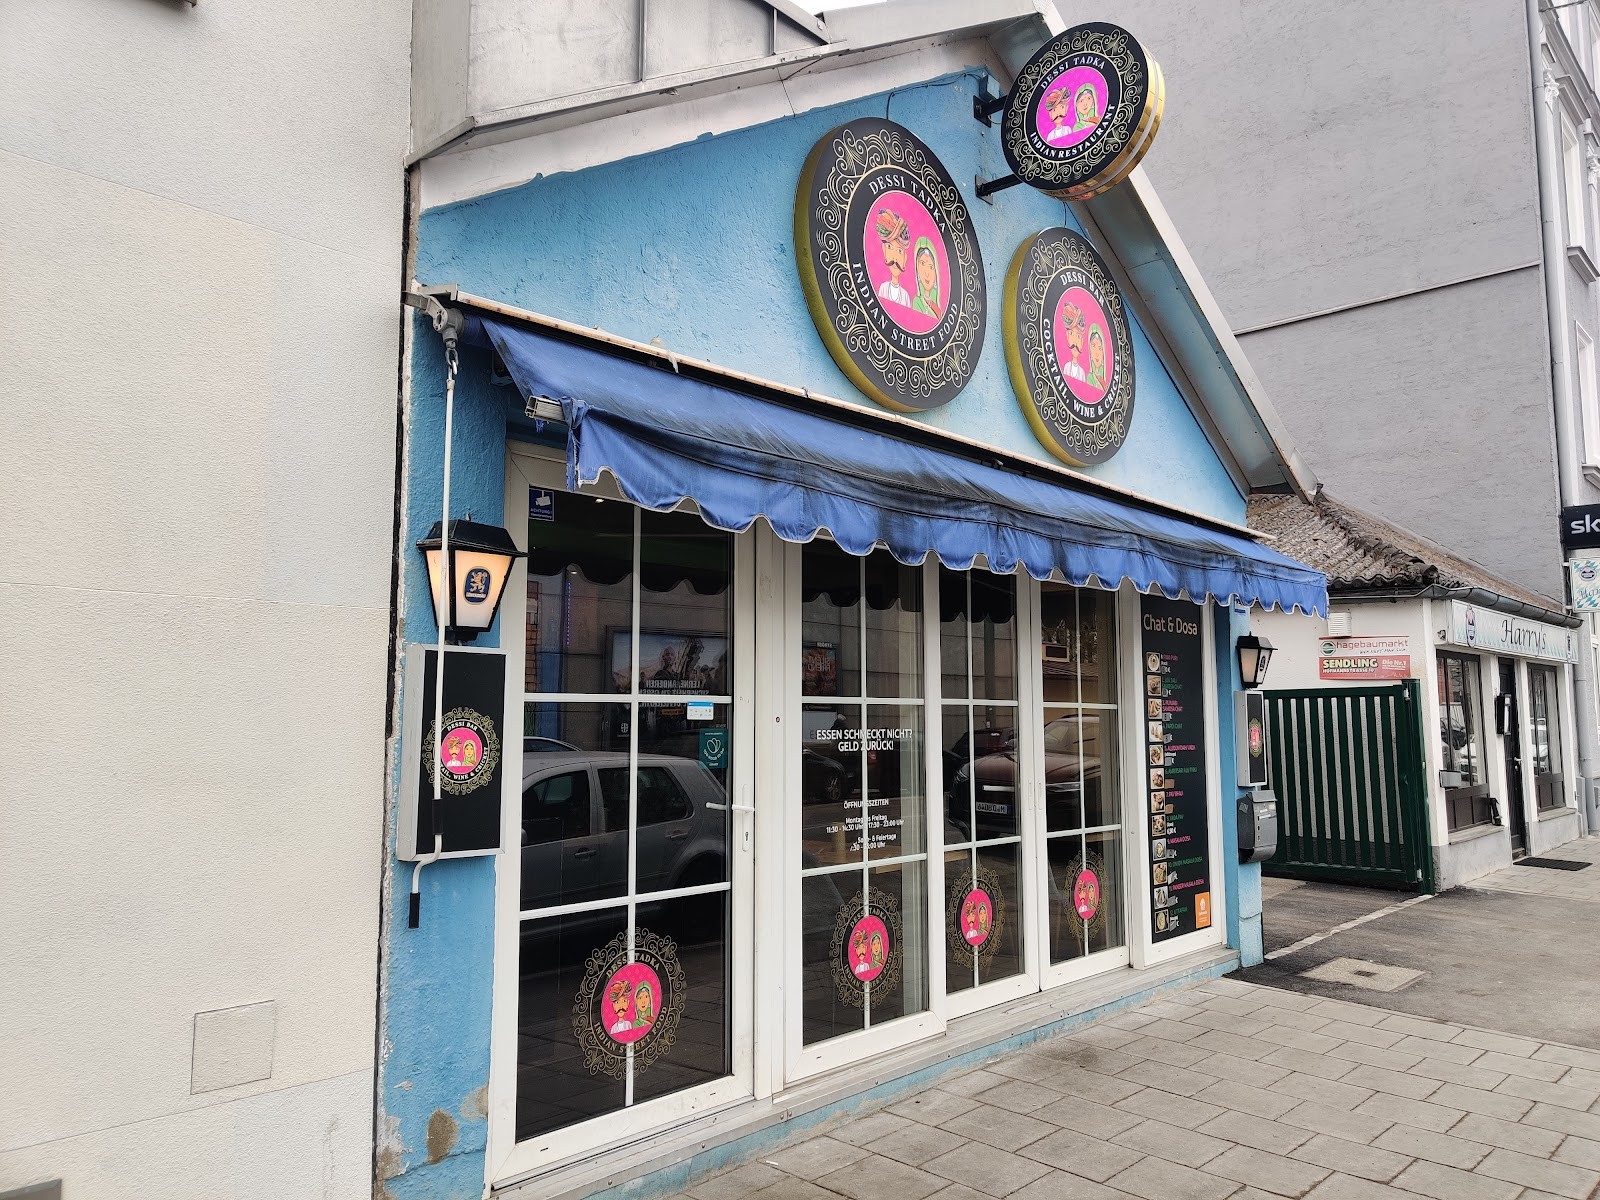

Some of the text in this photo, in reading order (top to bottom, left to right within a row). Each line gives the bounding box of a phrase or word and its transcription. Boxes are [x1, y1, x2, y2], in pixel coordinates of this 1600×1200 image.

[1040, 55, 1106, 90] DESSI TADKA
[1030, 103, 1116, 159] INDIAN RESTAURANT
[869, 174, 948, 234] DESSI TADKA
[1059, 271, 1106, 309] DESSI BAR
[852, 262, 959, 352] INDIAN STREET FOOD
[1043, 318, 1121, 418] COCKTAIL, WINE & CRICKET
[1570, 513, 1600, 535] sk
[1143, 613, 1198, 635] Chat & Dosa
[1336, 639, 1409, 650] hagebaumarkt
[1501, 617, 1547, 657] Harry's
[1322, 658, 1379, 669] SENDLING
[446, 721, 478, 732] DESSI BAR
[816, 729, 842, 740] ESSEN
[886, 728, 913, 739] NICHT?
[838, 741, 860, 752] GELD
[826, 825, 838, 833] 11:30
[871, 814, 888, 822] Freitag
[876, 833, 897, 841] Feiertage
[634, 952, 660, 971] TADKA
[594, 1022, 618, 1051] INDIAN
[652, 1005, 668, 1035] FOOD
